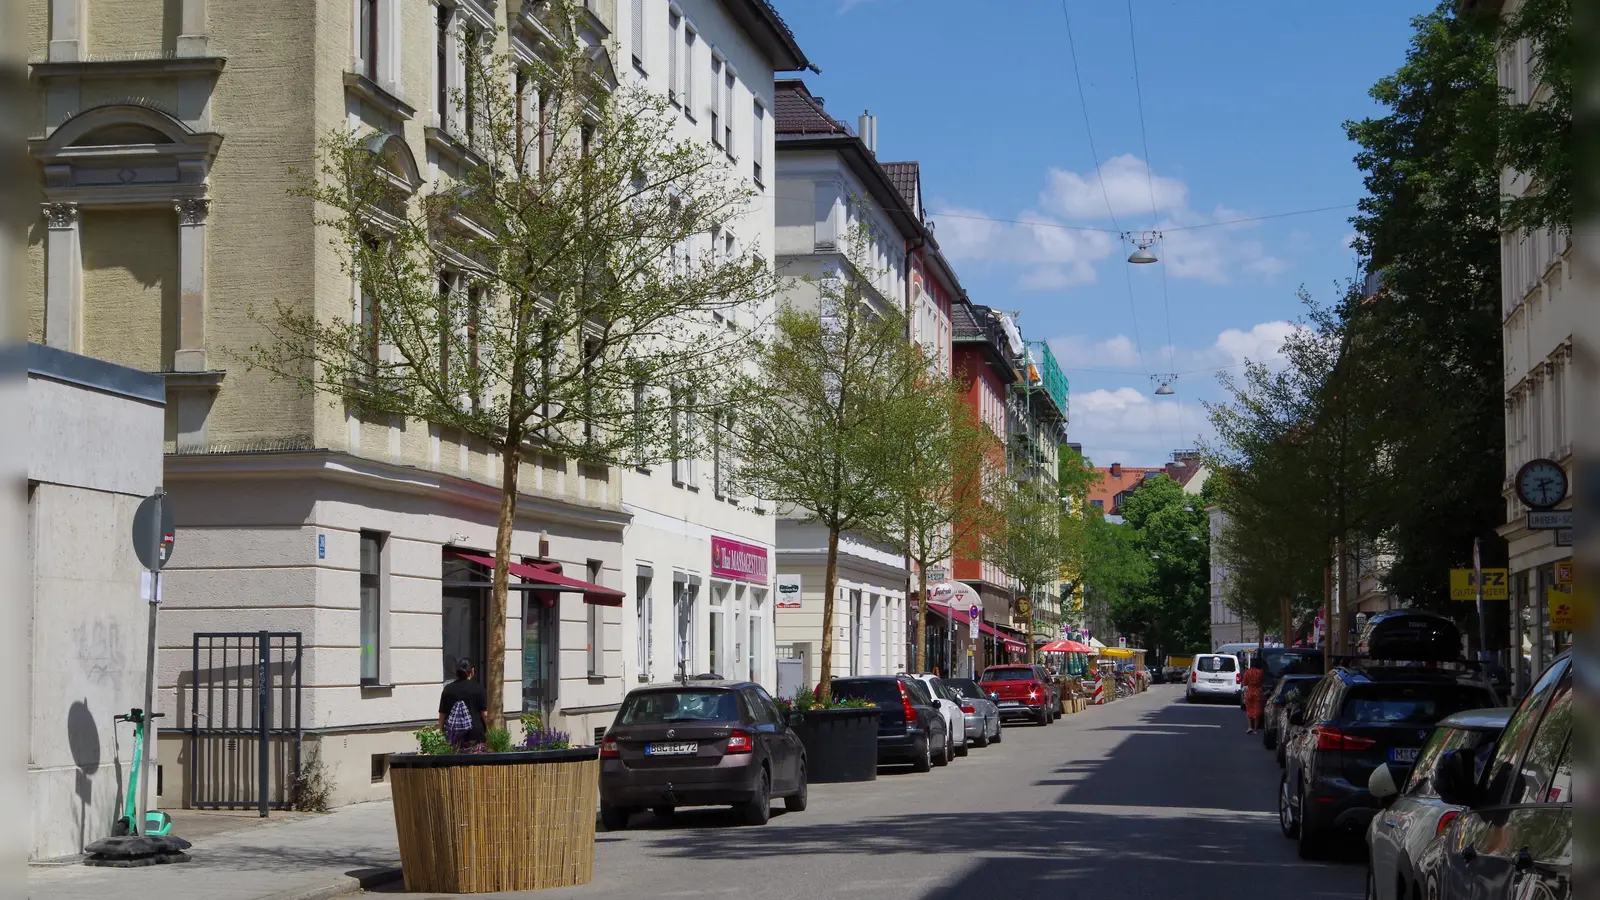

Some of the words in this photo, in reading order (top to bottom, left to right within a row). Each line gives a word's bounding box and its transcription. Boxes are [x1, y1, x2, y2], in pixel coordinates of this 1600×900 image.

[1531, 515, 1557, 524] UHREN
[721, 547, 731, 569] Thai
[1468, 572, 1505, 586] KFZ
